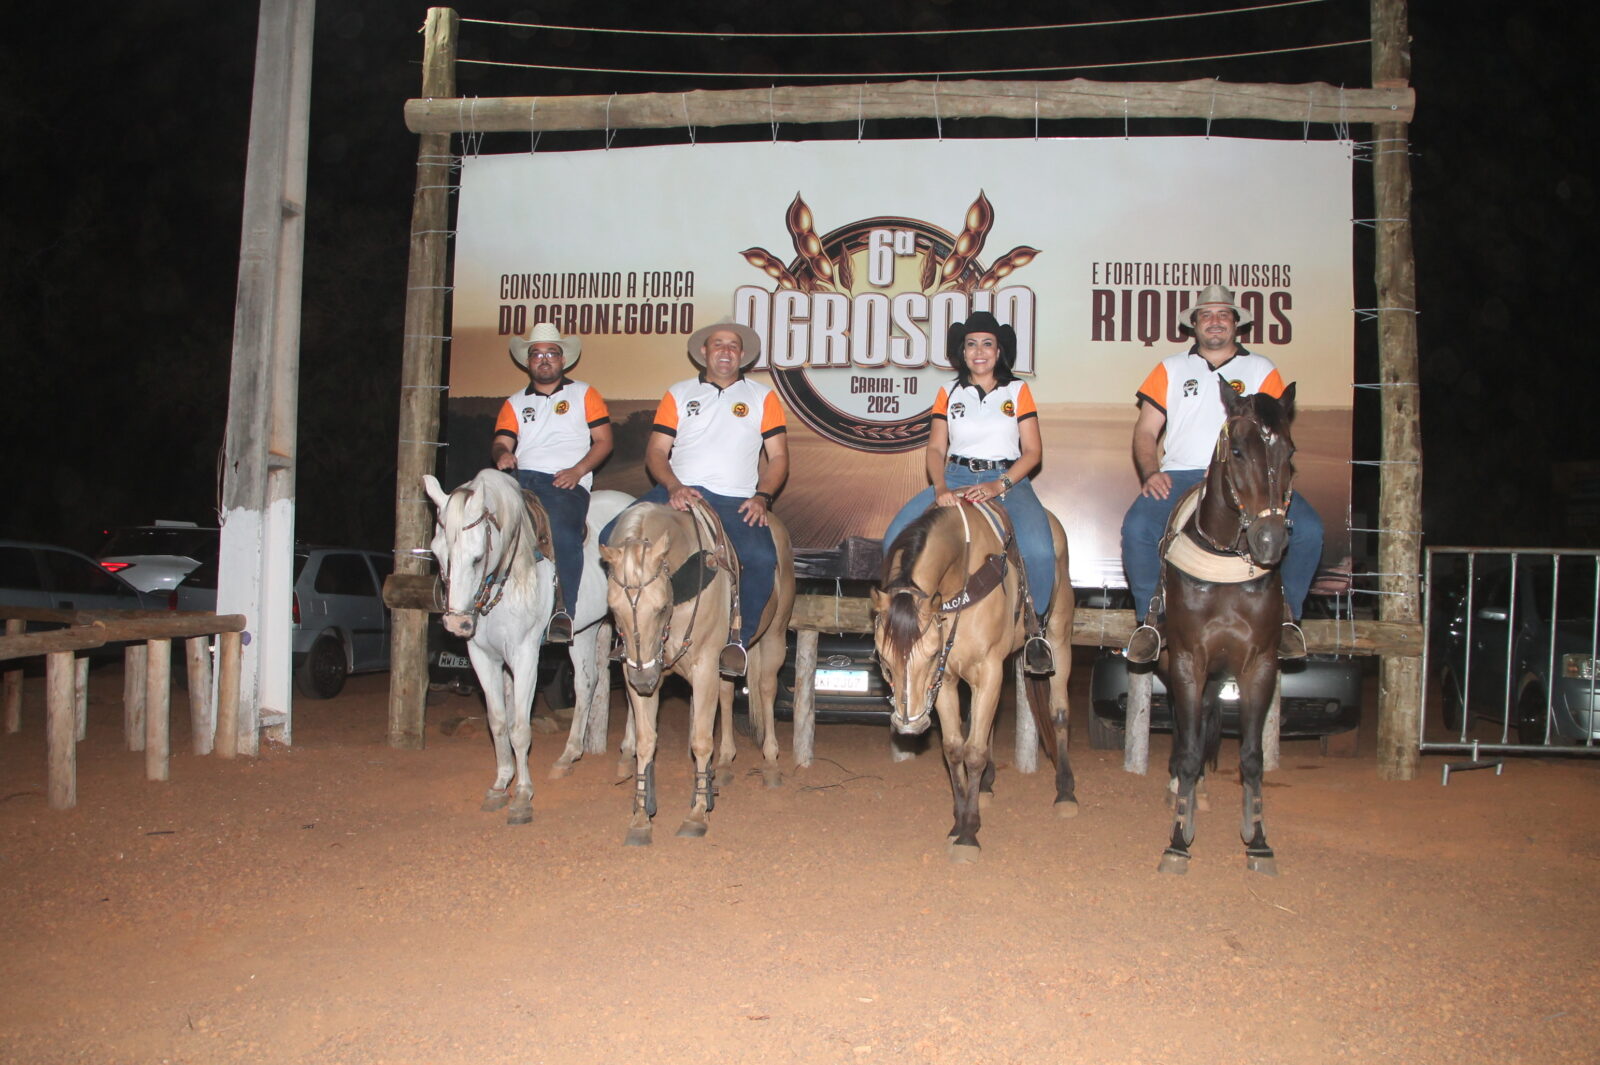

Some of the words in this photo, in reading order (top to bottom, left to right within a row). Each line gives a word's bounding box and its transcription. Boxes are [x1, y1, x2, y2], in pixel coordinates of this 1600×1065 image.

[500, 272, 622, 299] CONSOLIDANDO
[626, 272, 637, 298] A
[642, 271, 694, 301] FORÇA
[1092, 262, 1100, 285] E
[1105, 262, 1222, 286] FORTALECENDO
[1229, 264, 1291, 288] NOSSAS
[499, 304, 527, 336] DO
[534, 298, 694, 335] AGRONEGÓCIO
[734, 285, 1036, 376] AGROSOA
[1091, 289, 1292, 347] RIQUAS
[850, 376, 893, 394] CARIRI
[903, 376, 918, 394] TO
[867, 396, 900, 414] 2025
